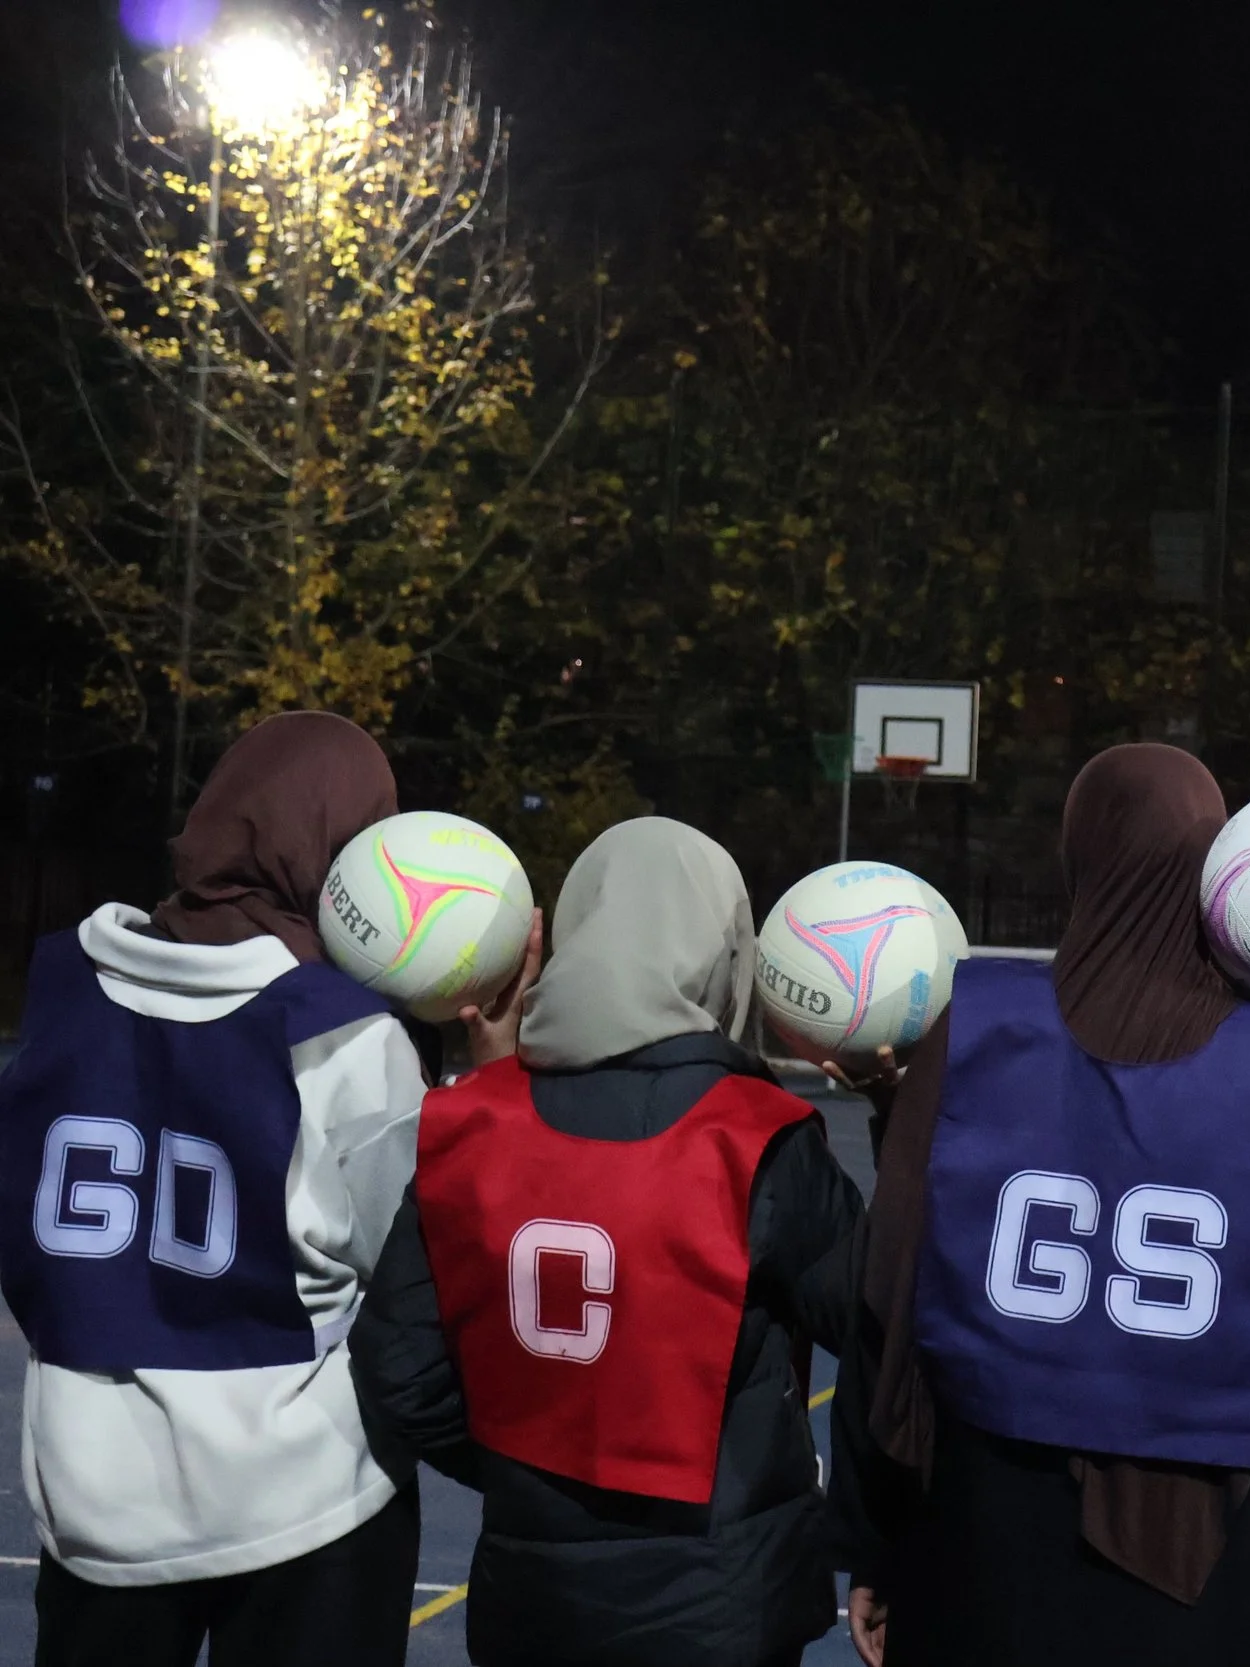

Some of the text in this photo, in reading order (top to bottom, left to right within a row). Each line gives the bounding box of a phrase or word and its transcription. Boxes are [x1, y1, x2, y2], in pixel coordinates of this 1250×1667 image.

[757, 950, 832, 1015] GILBE
[33, 1115, 237, 1279] GD
[985, 1169, 1228, 1340] GS
[508, 1218, 616, 1365] C
